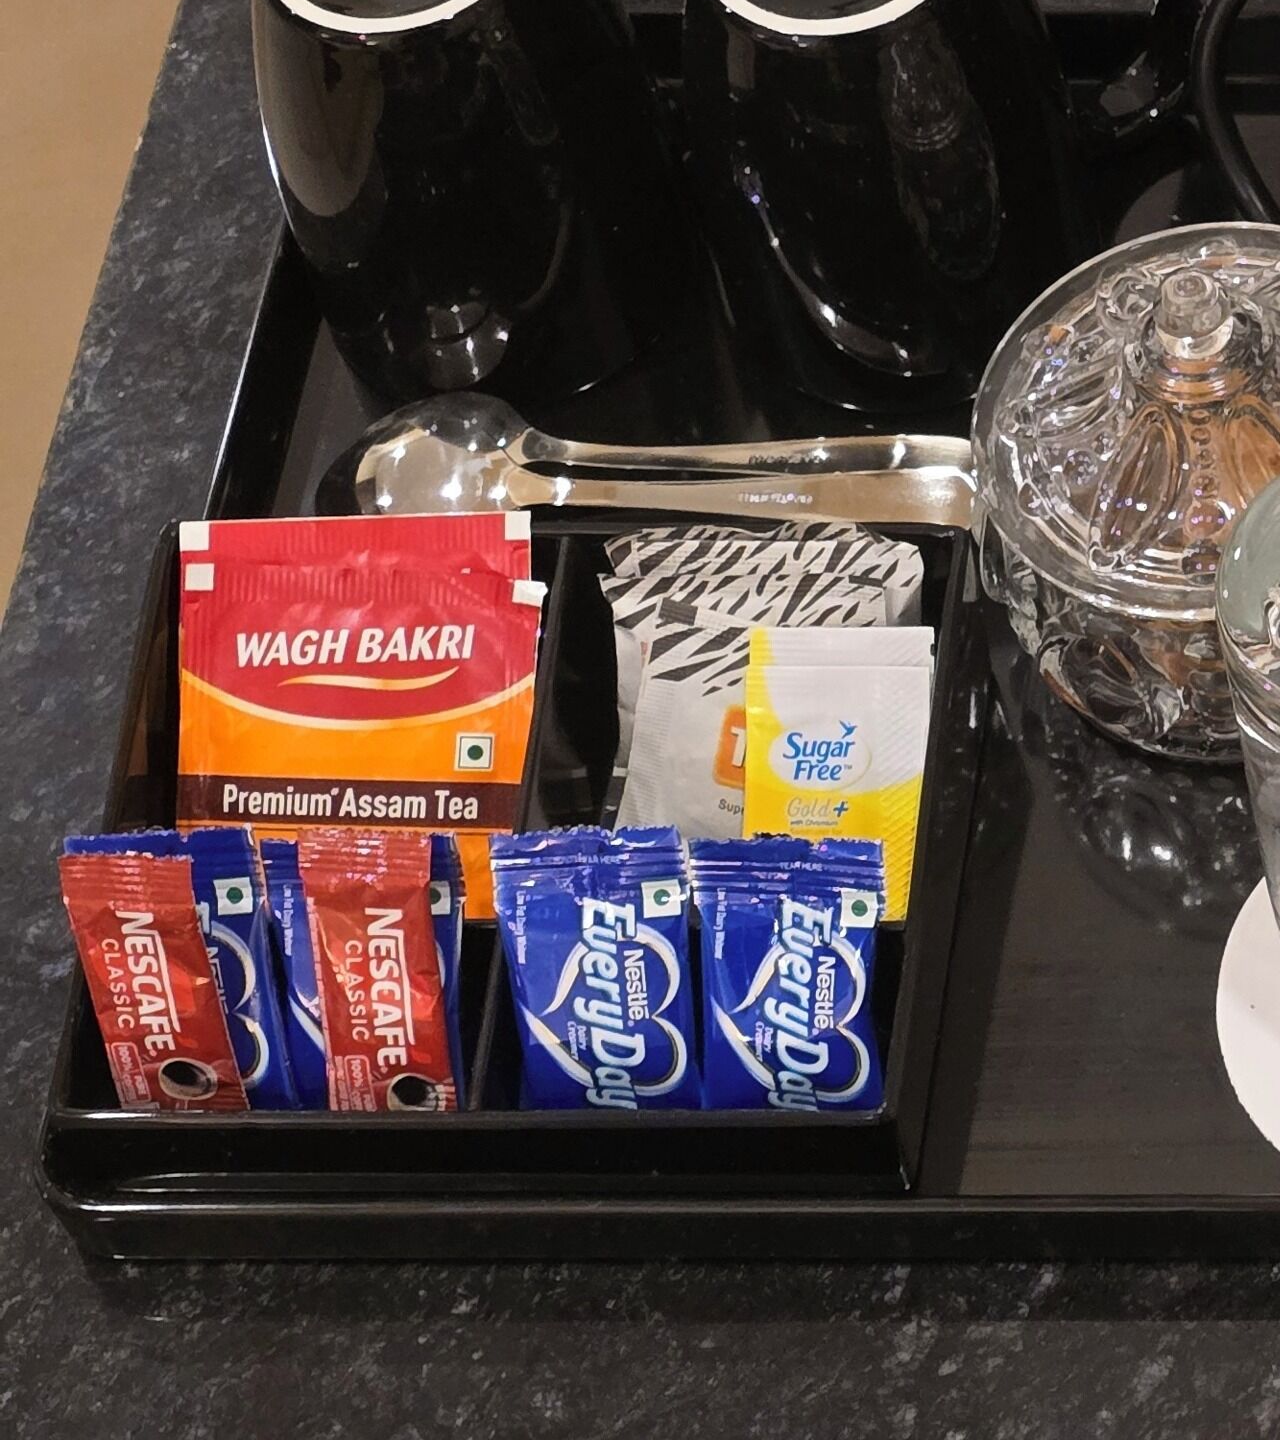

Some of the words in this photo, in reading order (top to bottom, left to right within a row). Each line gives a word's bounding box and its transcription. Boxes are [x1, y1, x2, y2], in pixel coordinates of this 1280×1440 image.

[236, 628, 350, 668] WAGH
[356, 624, 475, 664] BAKRI
[782, 731, 856, 764] Sugar
[338, 786, 427, 819] Assam
[434, 789, 479, 820] Tea
[101, 938, 136, 1030] CLASSIC
[345, 940, 371, 1042] CLASSIC
